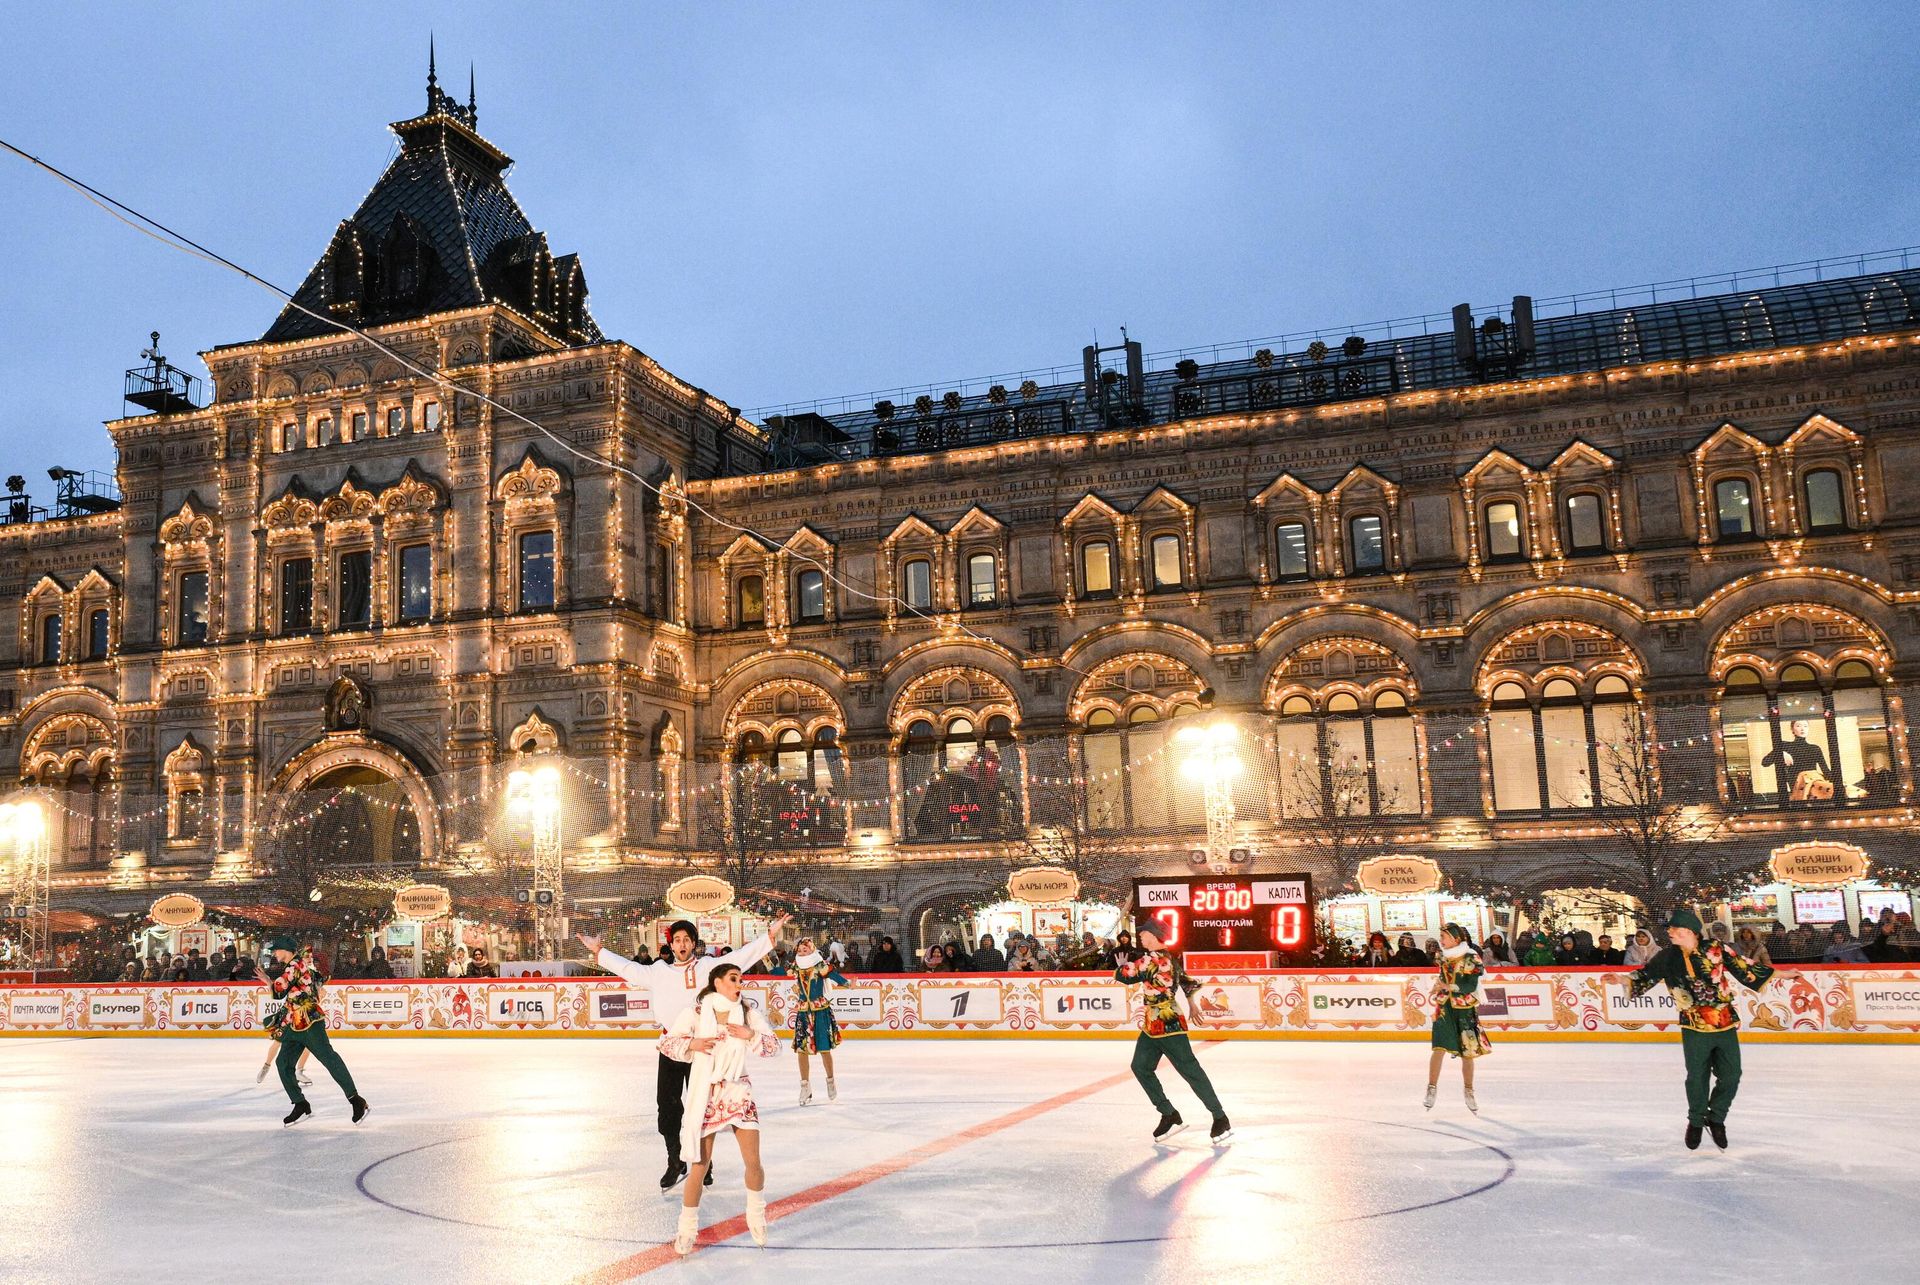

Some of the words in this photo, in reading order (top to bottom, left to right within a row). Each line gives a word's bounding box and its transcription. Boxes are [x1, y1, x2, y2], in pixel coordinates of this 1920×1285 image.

[949, 804, 980, 813] ISAIA
[779, 811, 809, 820] ISAIA
[1795, 855, 1841, 864] БЕЛЯШИ
[1383, 867, 1414, 875] БУРКА
[1786, 866, 1794, 874] И
[1798, 865, 1853, 874] ЧЕБУРЕКИ
[1381, 877, 1387, 885] В
[1389, 877, 1418, 885] БУЛКЕ
[1018, 882, 1042, 891] ДАРЫ
[1043, 882, 1068, 890] МОРЯ
[1206, 883, 1237, 891] ВРЕМЯ
[401, 894, 443, 902] ВАНИЛЬНЫЙ
[680, 891, 721, 901] ПОНЧИКИ
[1148, 889, 1179, 902] СКМК
[1268, 887, 1302, 900] КАЛУГА
[165, 907, 196, 915] АННУШКИ
[1193, 918, 1254, 928] ПЕРИОД/ТАЙМ
[1224, 928, 1232, 947] 1
[1864, 991, 1920, 1001] ИНГОСС
[352, 1000, 403, 1009] EXEED
[517, 1001, 543, 1012] ПСБ
[1079, 998, 1112, 1010] ПСБ
[1330, 996, 1397, 1009] купер
[1612, 995, 1655, 1008] ПОЧТА
[14, 1005, 34, 1015] ПОЧТА
[36, 1005, 60, 1014] РОССИИ
[102, 1004, 141, 1015] купер
[195, 1003, 218, 1013] ПСБ
